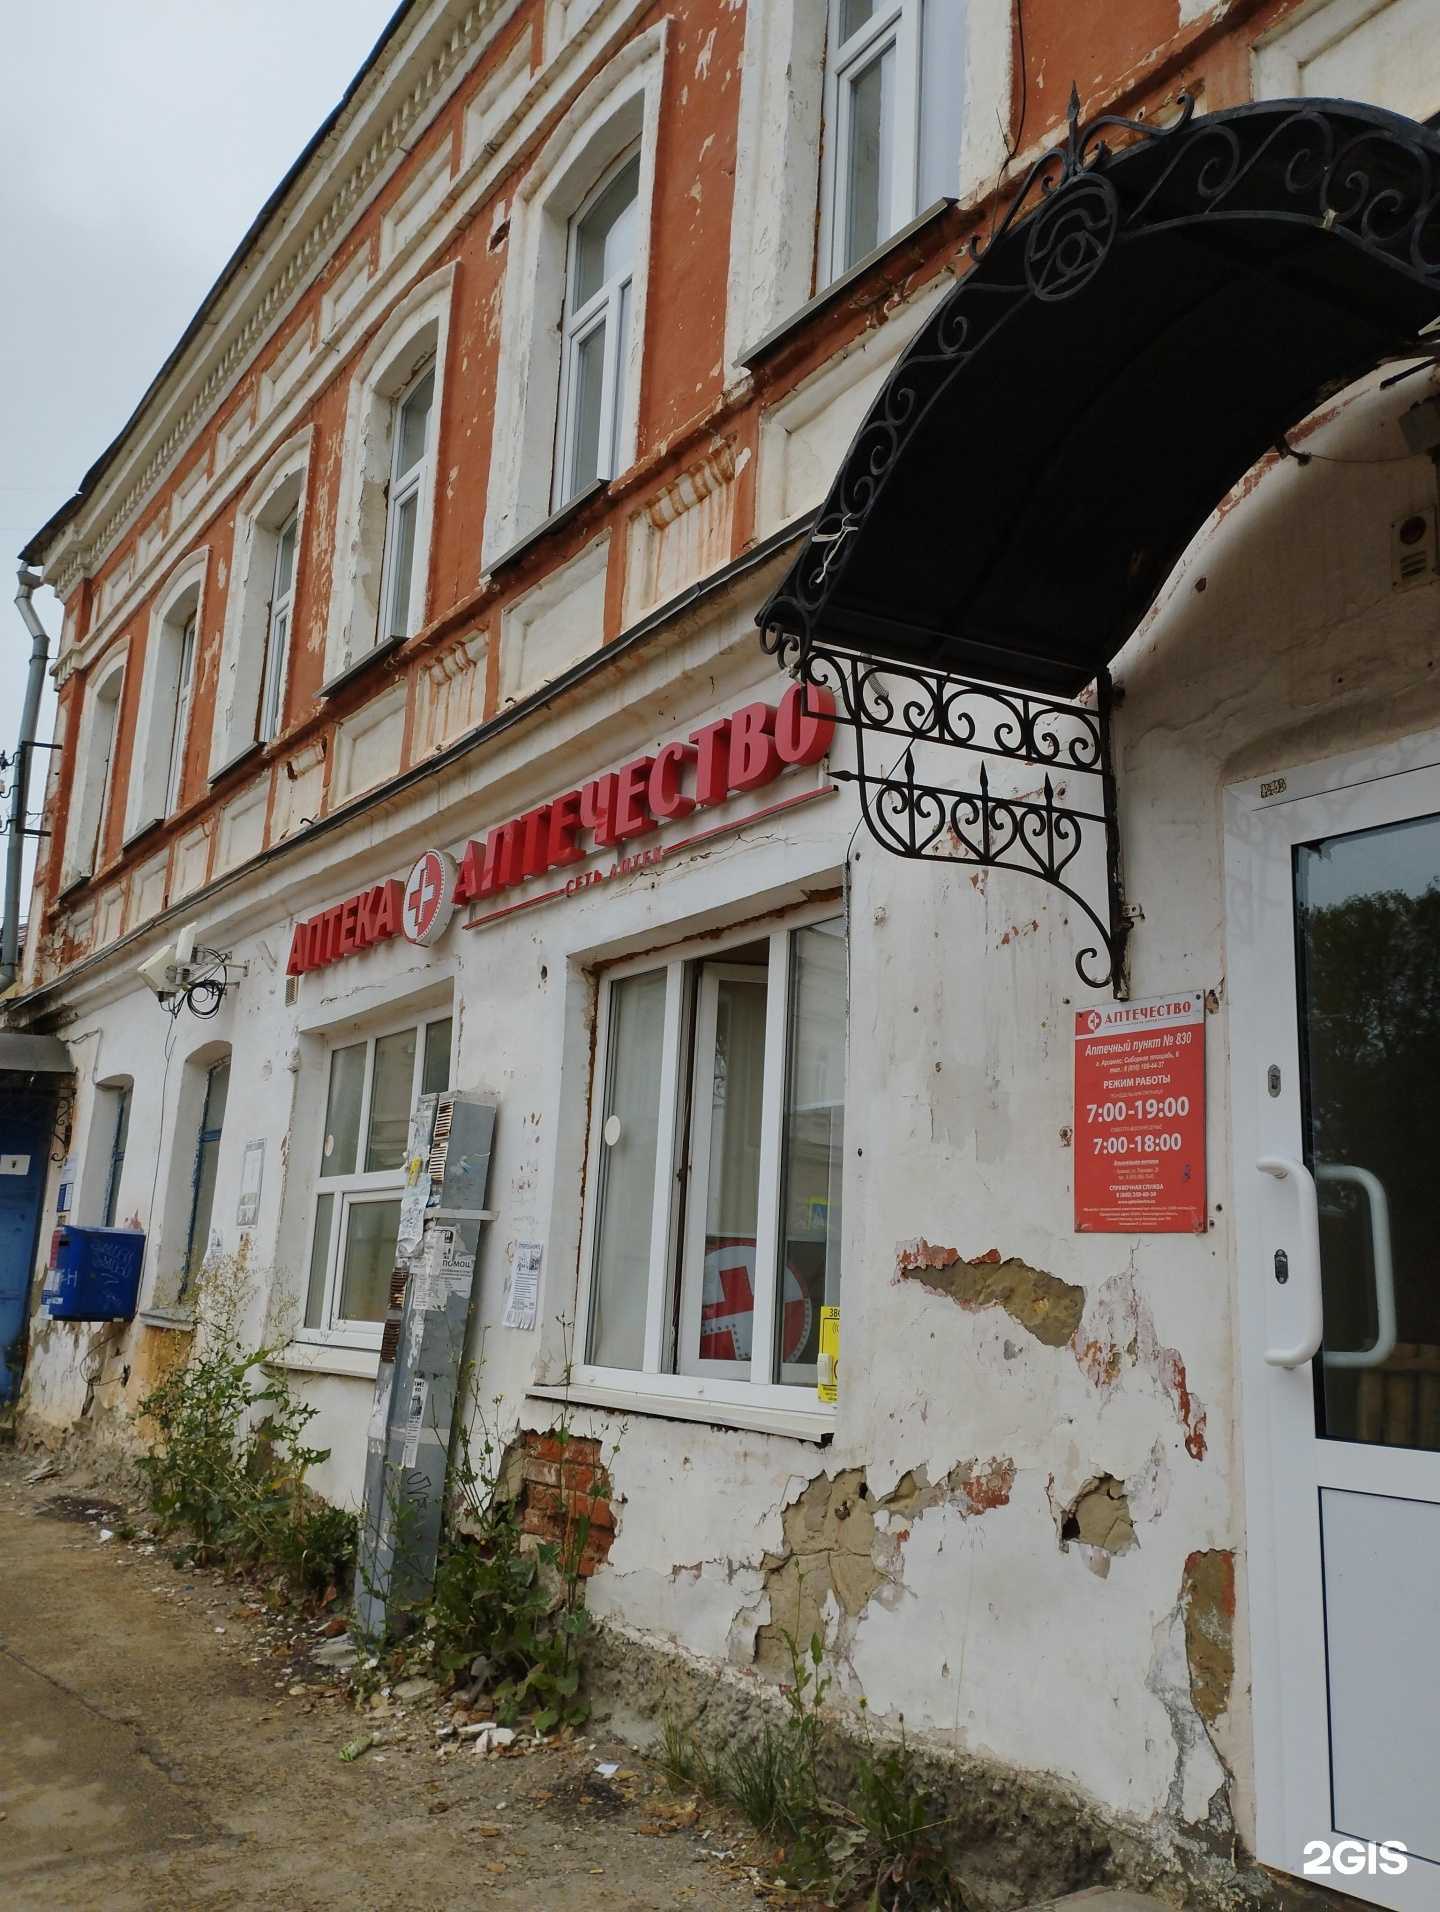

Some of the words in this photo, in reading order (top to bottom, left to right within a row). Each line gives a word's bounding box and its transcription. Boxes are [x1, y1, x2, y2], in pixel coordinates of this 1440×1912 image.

[452, 681, 837, 906] АПТЕЧЕСТВО
[286, 878, 405, 977] АПТЕКА
[1104, 1000, 1192, 1025] АПТЕЧЕСТВО
[1085, 1039, 1131, 1057] Аптечный
[1132, 1037, 1161, 1053] пункт
[1163, 1035, 1174, 1046] №
[1176, 1031, 1192, 1045] 830
[1103, 1077, 1134, 1090] РЕЖИМ
[1135, 1074, 1171, 1087] РАБОТЫ
[1086, 1096, 1190, 1124] 7:00-19:00
[1093, 1133, 1182, 1155] 7:00-18:00
